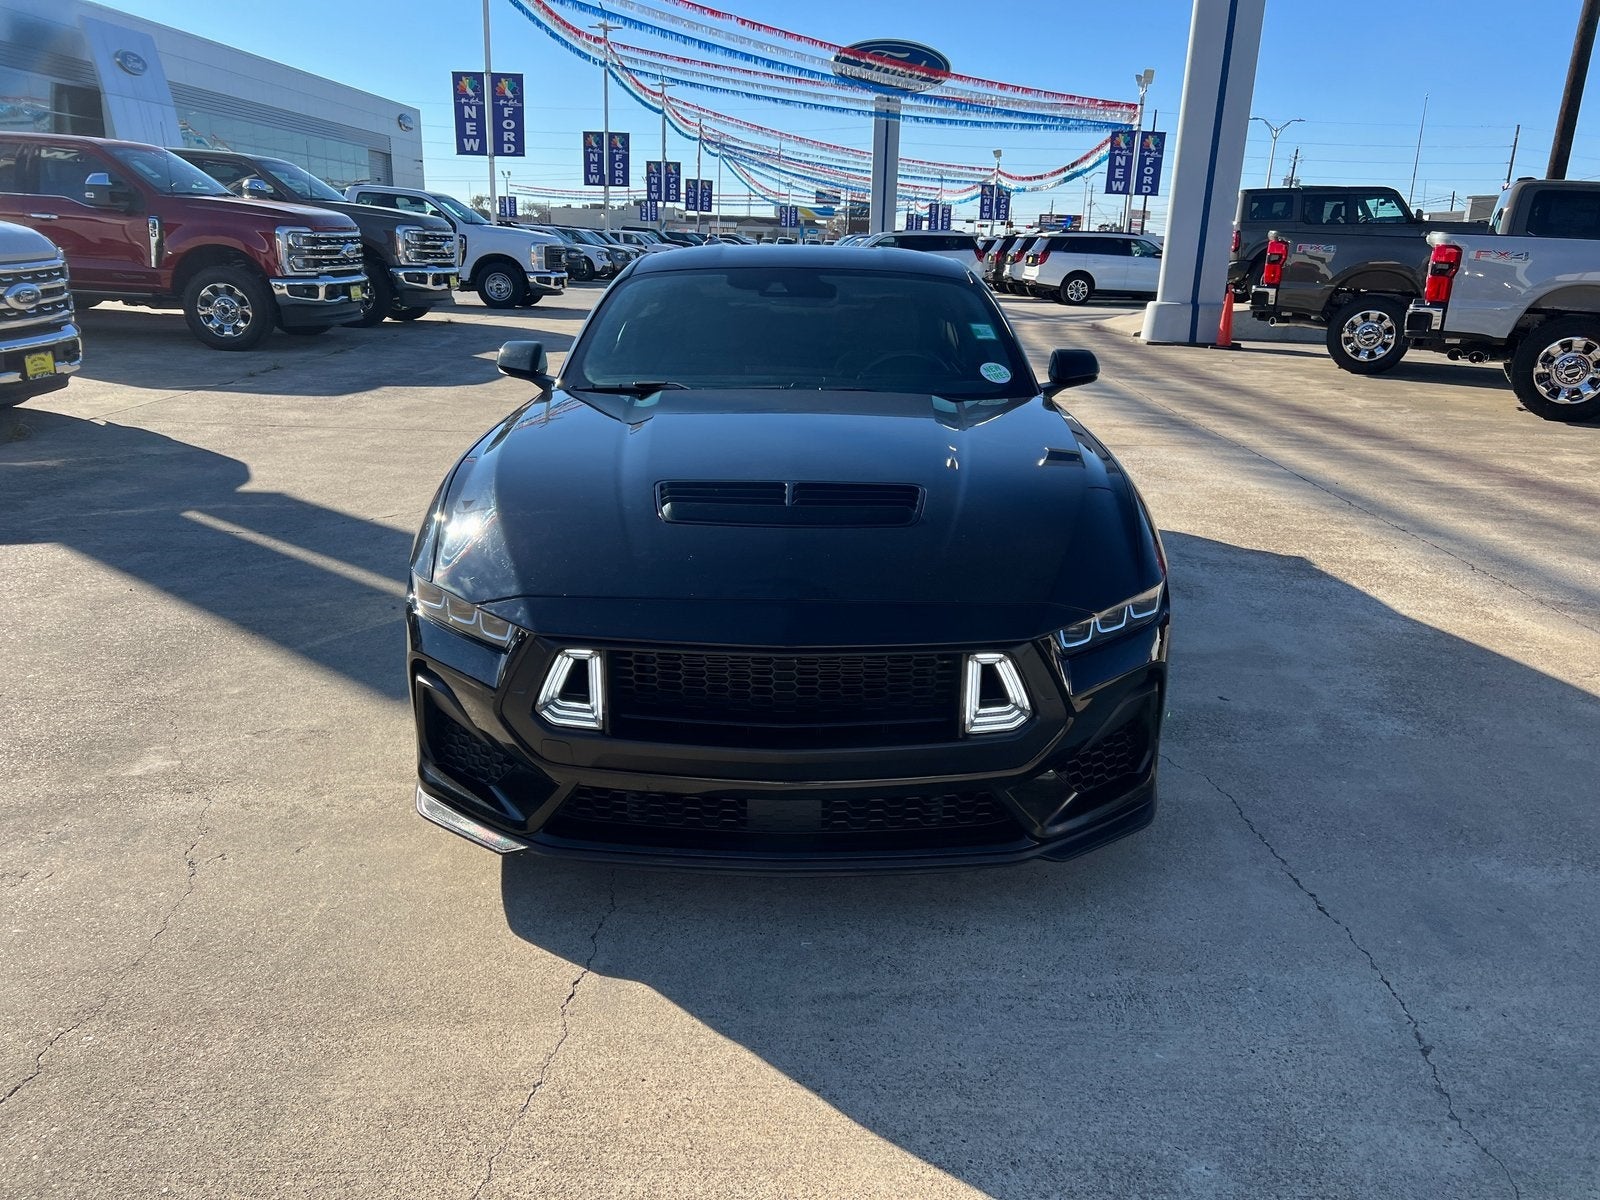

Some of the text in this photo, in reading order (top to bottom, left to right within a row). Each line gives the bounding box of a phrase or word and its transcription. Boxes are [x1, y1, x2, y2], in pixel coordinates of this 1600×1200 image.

[463, 105, 480, 152] NEW
[502, 107, 516, 154] FORD
[588, 153, 600, 184] NEW
[614, 154, 624, 185] FORD
[1111, 155, 1127, 192] NEW
[1141, 157, 1155, 194] FORD
[650, 177, 659, 200] NEW
[669, 177, 677, 201] FORD
[687, 191, 696, 210] NEW
[982, 198, 991, 219] NEW
[1296, 244, 1336, 253] FX4
[1474, 250, 1530, 262] FX4
[982, 364, 1002, 374] NEW
